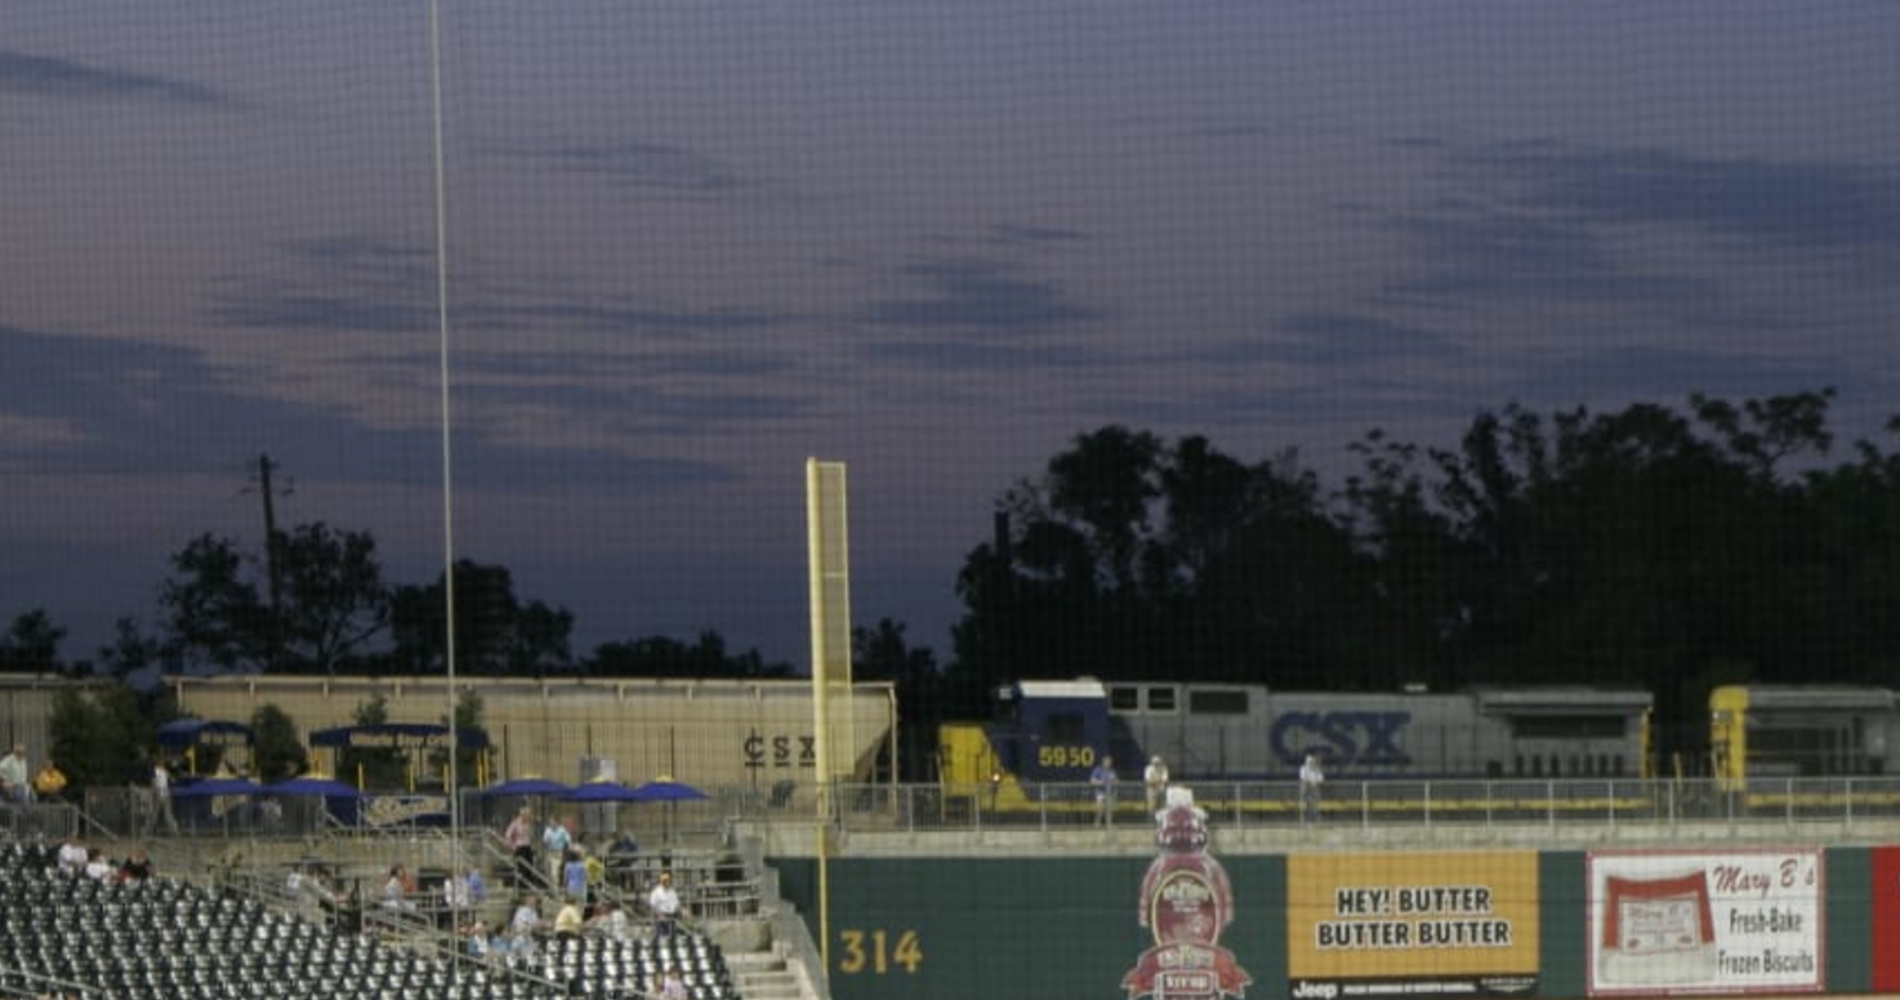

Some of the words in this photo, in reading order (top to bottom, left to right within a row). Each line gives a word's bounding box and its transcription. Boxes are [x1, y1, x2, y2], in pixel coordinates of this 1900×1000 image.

[1270, 711, 1411, 766] CSX
[1039, 746, 1095, 768] 5950
[1713, 863, 1772, 897] Mary
[1337, 888, 1391, 914] HEY!
[1398, 887, 1491, 913] BUTTER
[1318, 922, 1410, 947] BUTTER
[1418, 921, 1510, 945] BUTTER
[1730, 908, 1804, 935] Fresh-Bake
[840, 930, 923, 974] 314
[1718, 950, 1760, 976] Frozen
[1763, 949, 1814, 975] Biscuits
[1293, 981, 1339, 1000] Jeep
